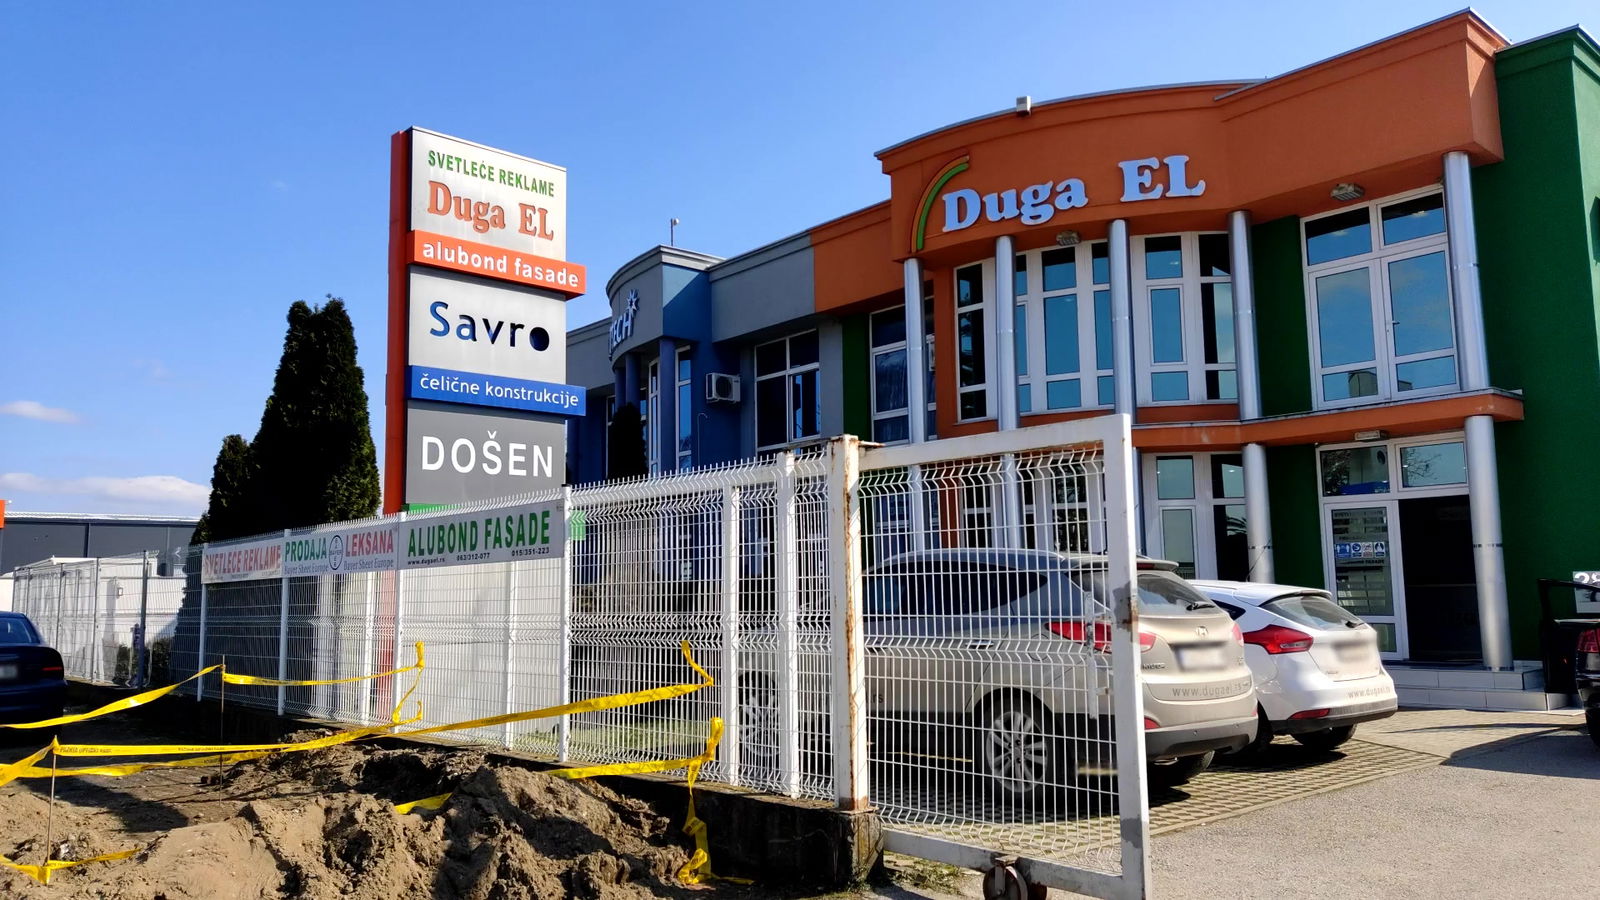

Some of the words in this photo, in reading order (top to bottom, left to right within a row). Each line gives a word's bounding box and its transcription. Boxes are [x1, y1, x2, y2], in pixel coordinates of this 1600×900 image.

[499, 169, 555, 197] REKLAME
[942, 178, 1089, 233] Duga
[1117, 154, 1206, 202] EL
[427, 180, 506, 234] Duga
[518, 202, 555, 241] EL
[422, 241, 507, 273] alubond
[514, 257, 579, 287] fasade
[429, 301, 550, 351] Savro
[420, 373, 480, 395] čelične
[485, 381, 579, 409] konstrukcije
[421, 430, 553, 478] DOŠEN
[284, 537, 327, 562] PRODAJA
[345, 529, 394, 557] LEKSANA
[407, 520, 479, 557] ALUBOND
[484, 510, 551, 549] FASADE
[243, 544, 282, 571] REKLAME
